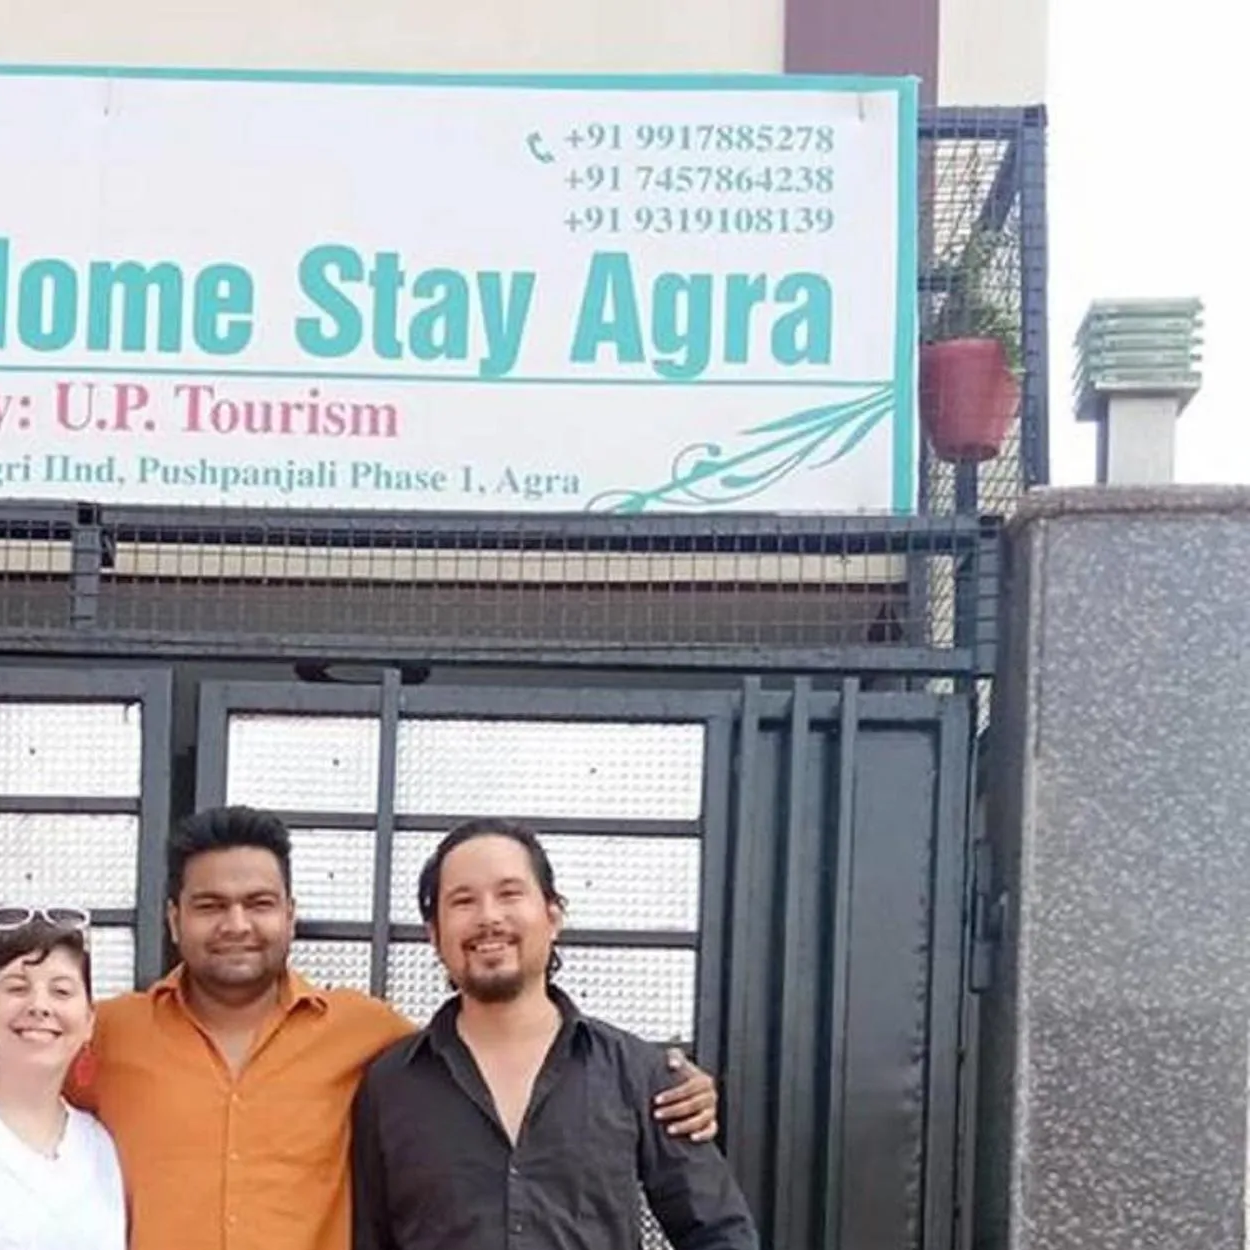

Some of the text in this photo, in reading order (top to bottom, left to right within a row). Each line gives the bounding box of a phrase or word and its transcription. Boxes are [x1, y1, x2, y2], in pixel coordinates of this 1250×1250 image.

[564, 123, 835, 153] +91 9917885278
[564, 164, 835, 193] +91 7457864238
[563, 206, 835, 235] +91 9319108139
[293, 243, 537, 378] Stay
[568, 250, 835, 379] Agra
[55, 381, 157, 433] U.P.
[174, 383, 400, 438] Tourism
[138, 456, 338, 493] Pushpanjali
[350, 461, 448, 493] Phase
[496, 467, 581, 500] Agra
